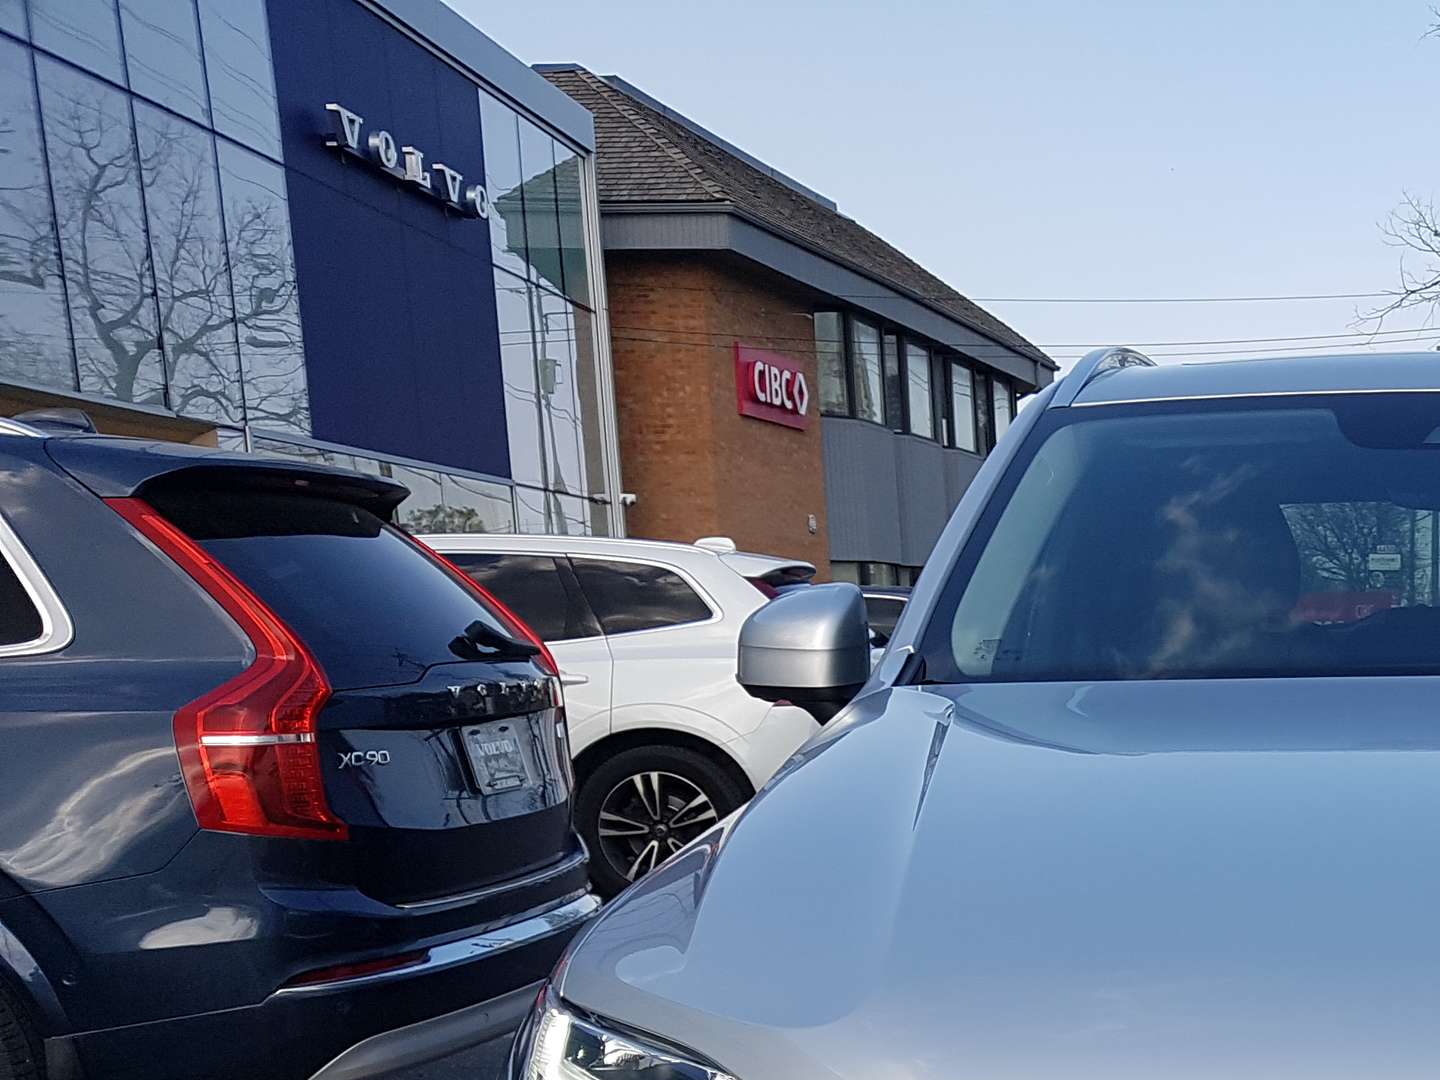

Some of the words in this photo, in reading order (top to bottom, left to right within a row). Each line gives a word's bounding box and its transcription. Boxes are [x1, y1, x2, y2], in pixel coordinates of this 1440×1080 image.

[325, 103, 489, 219] VOLVO
[754, 361, 793, 409] CIBC
[338, 750, 391, 768] XC90
